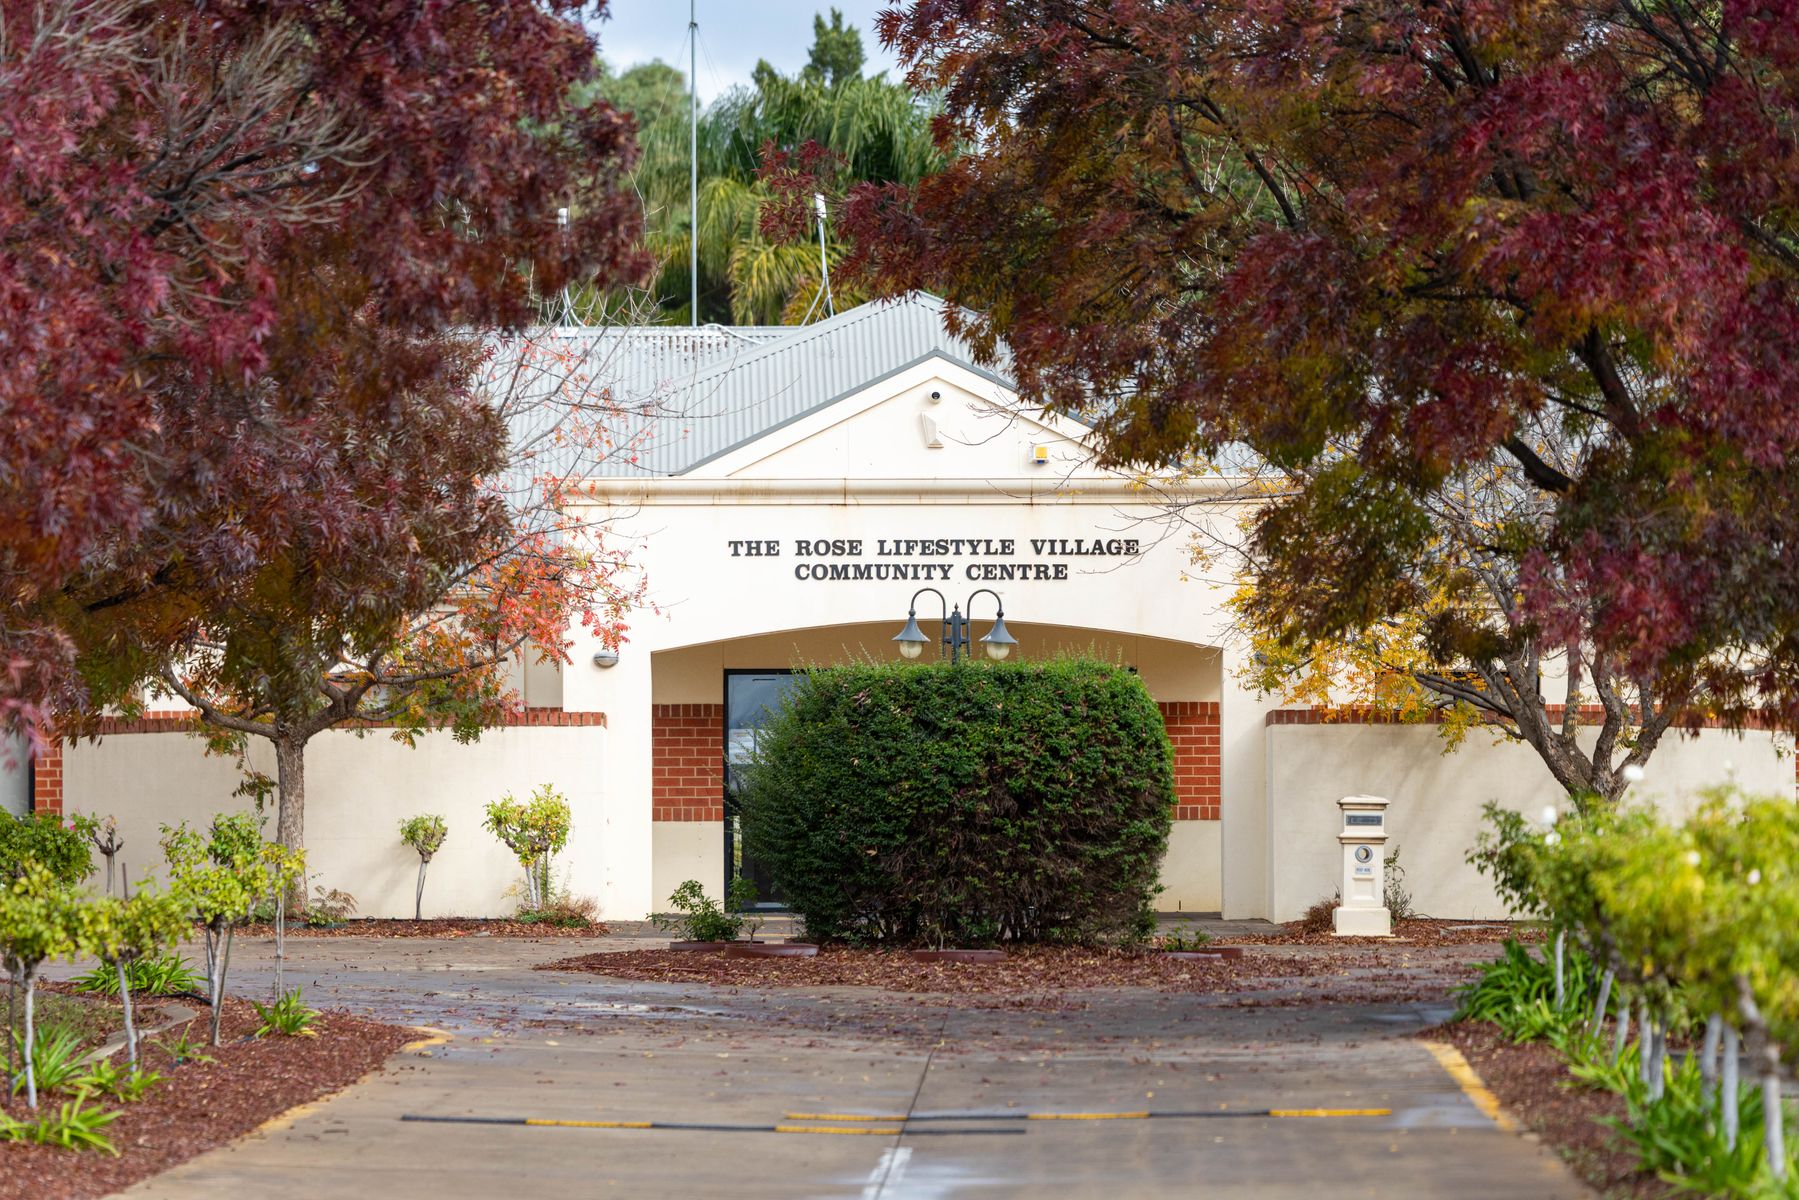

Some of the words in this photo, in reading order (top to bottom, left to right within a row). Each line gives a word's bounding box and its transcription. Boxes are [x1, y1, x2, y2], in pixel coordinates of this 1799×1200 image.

[728, 540, 780, 557] THE
[795, 539, 862, 556] ROSE
[877, 539, 1015, 556] LIFESTYLE
[1030, 539, 1140, 556] VILLAGE
[794, 563, 953, 581] COMMUNITY
[965, 563, 1068, 581] CENTRE
